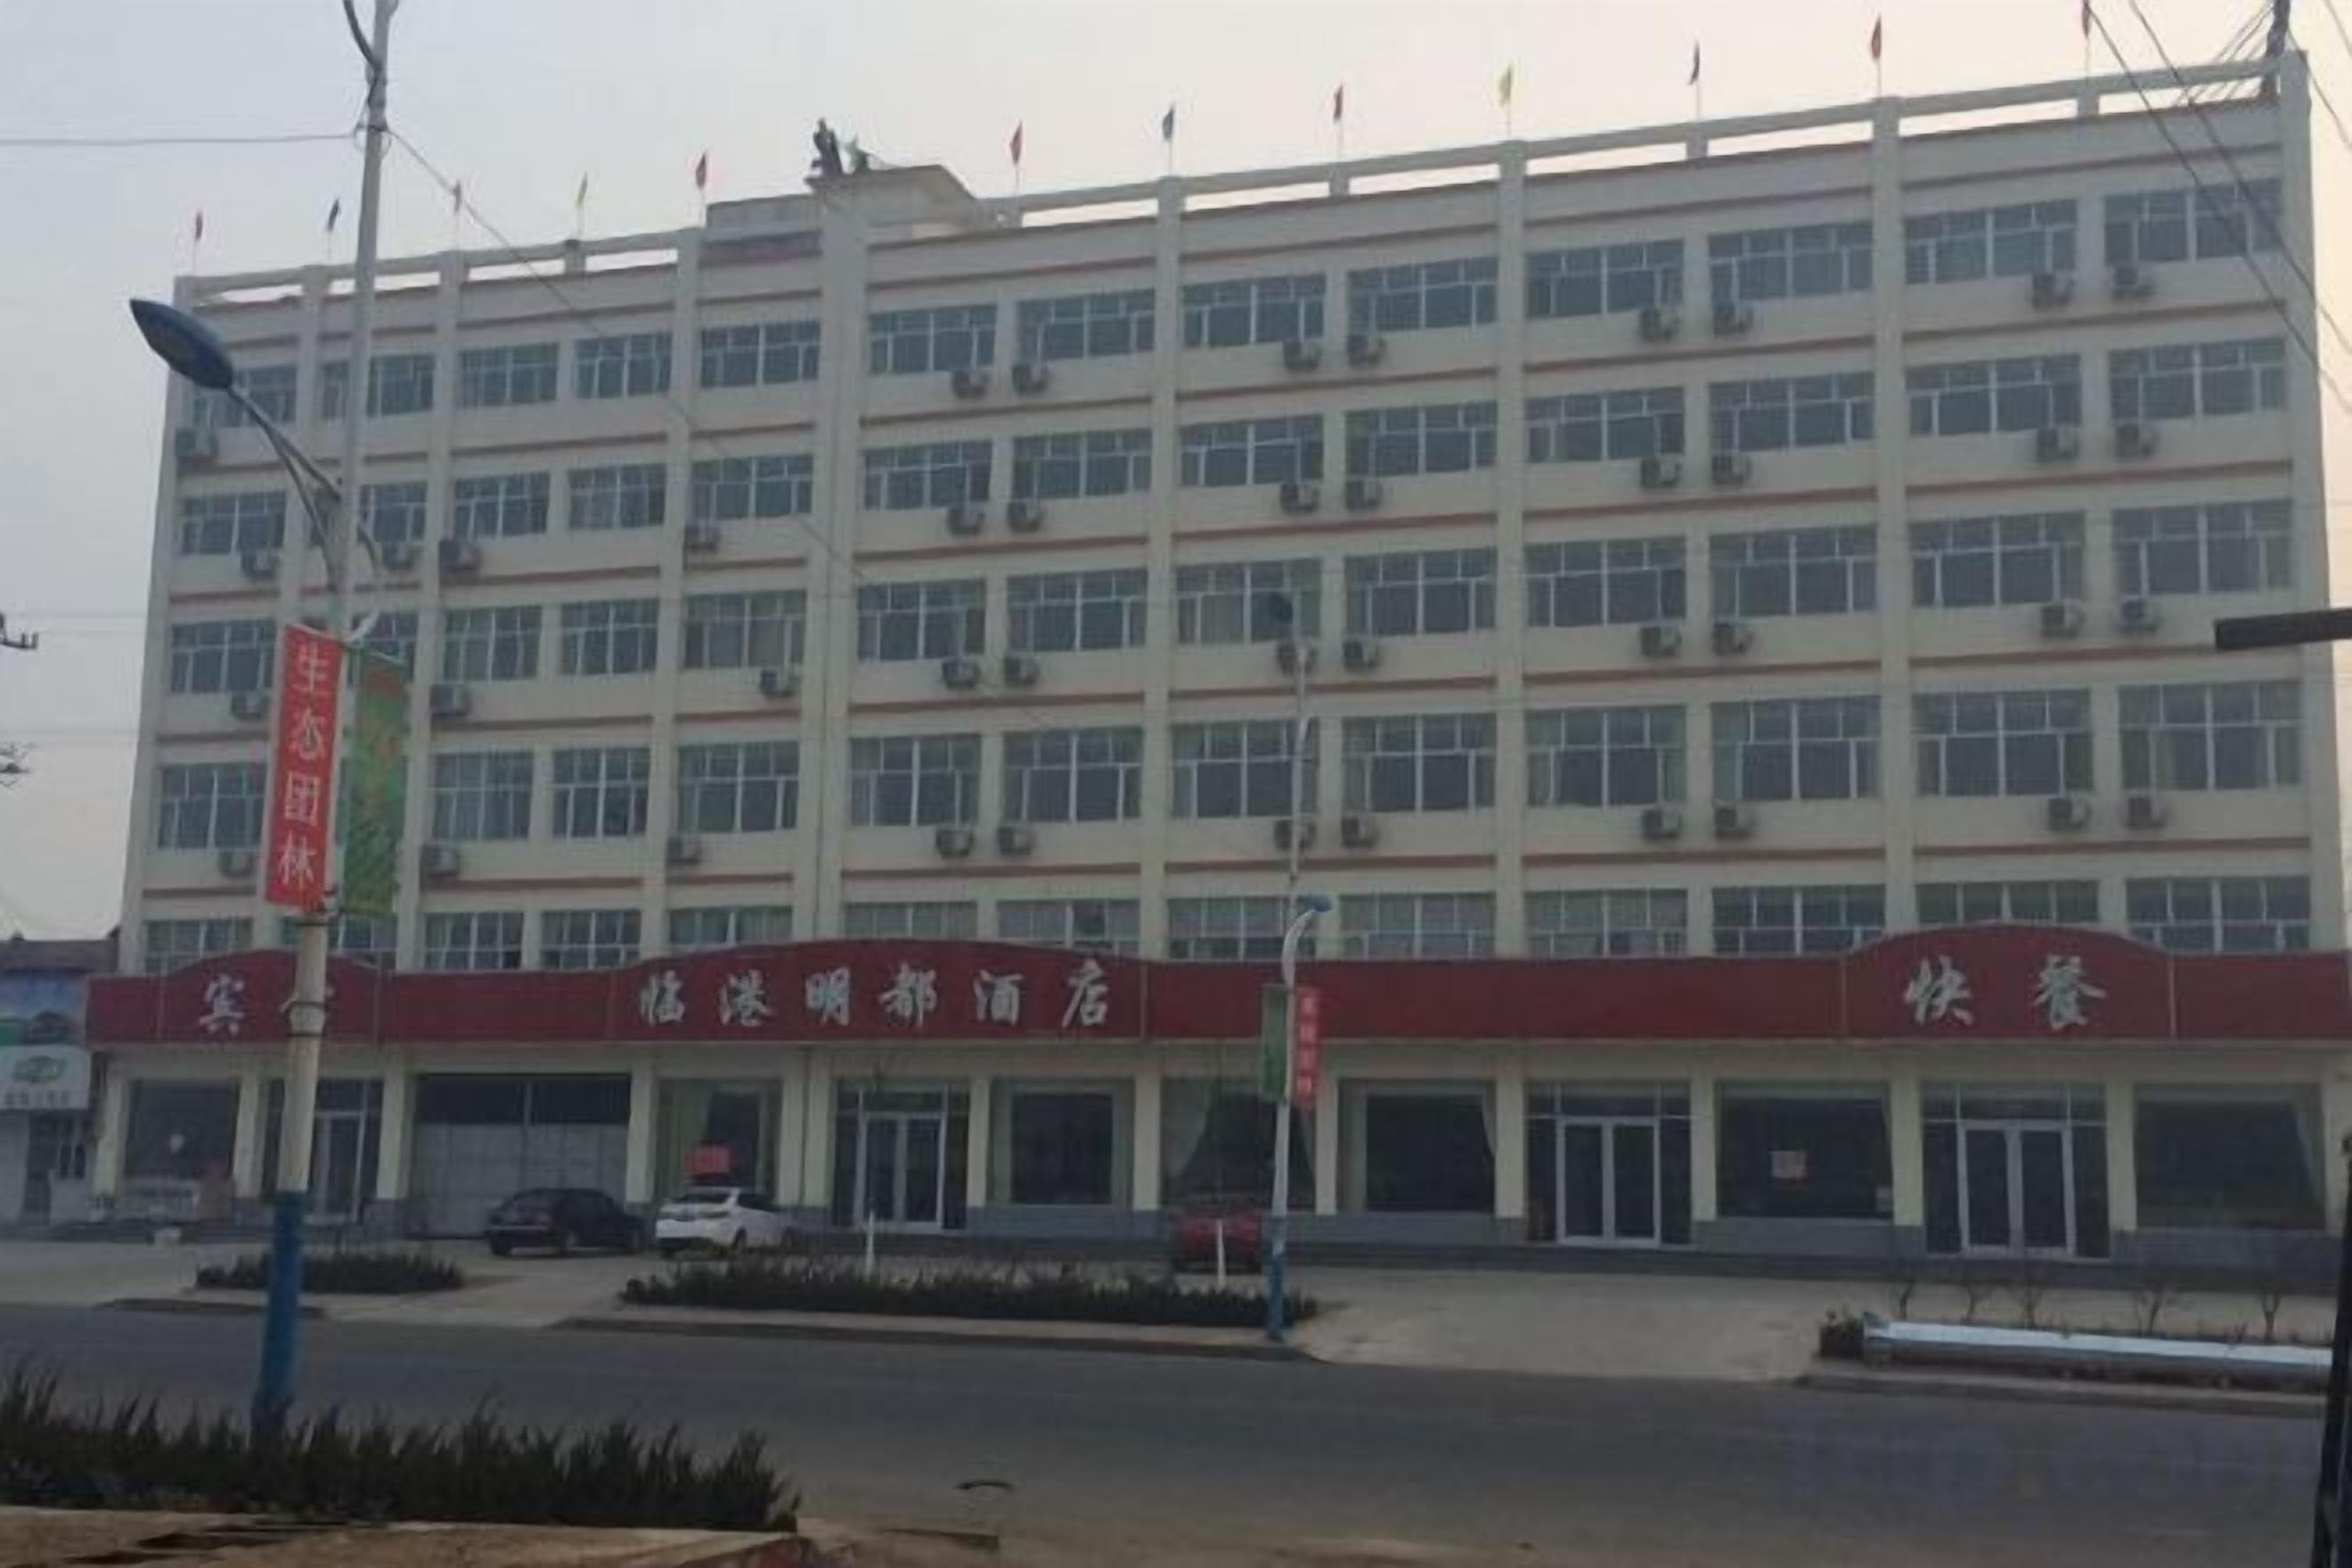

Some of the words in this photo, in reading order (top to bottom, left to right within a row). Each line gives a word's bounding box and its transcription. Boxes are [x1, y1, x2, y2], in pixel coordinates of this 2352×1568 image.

[639, 960, 1110, 1028] 临港明都酒店
[1903, 954, 2108, 1030] 快餐
